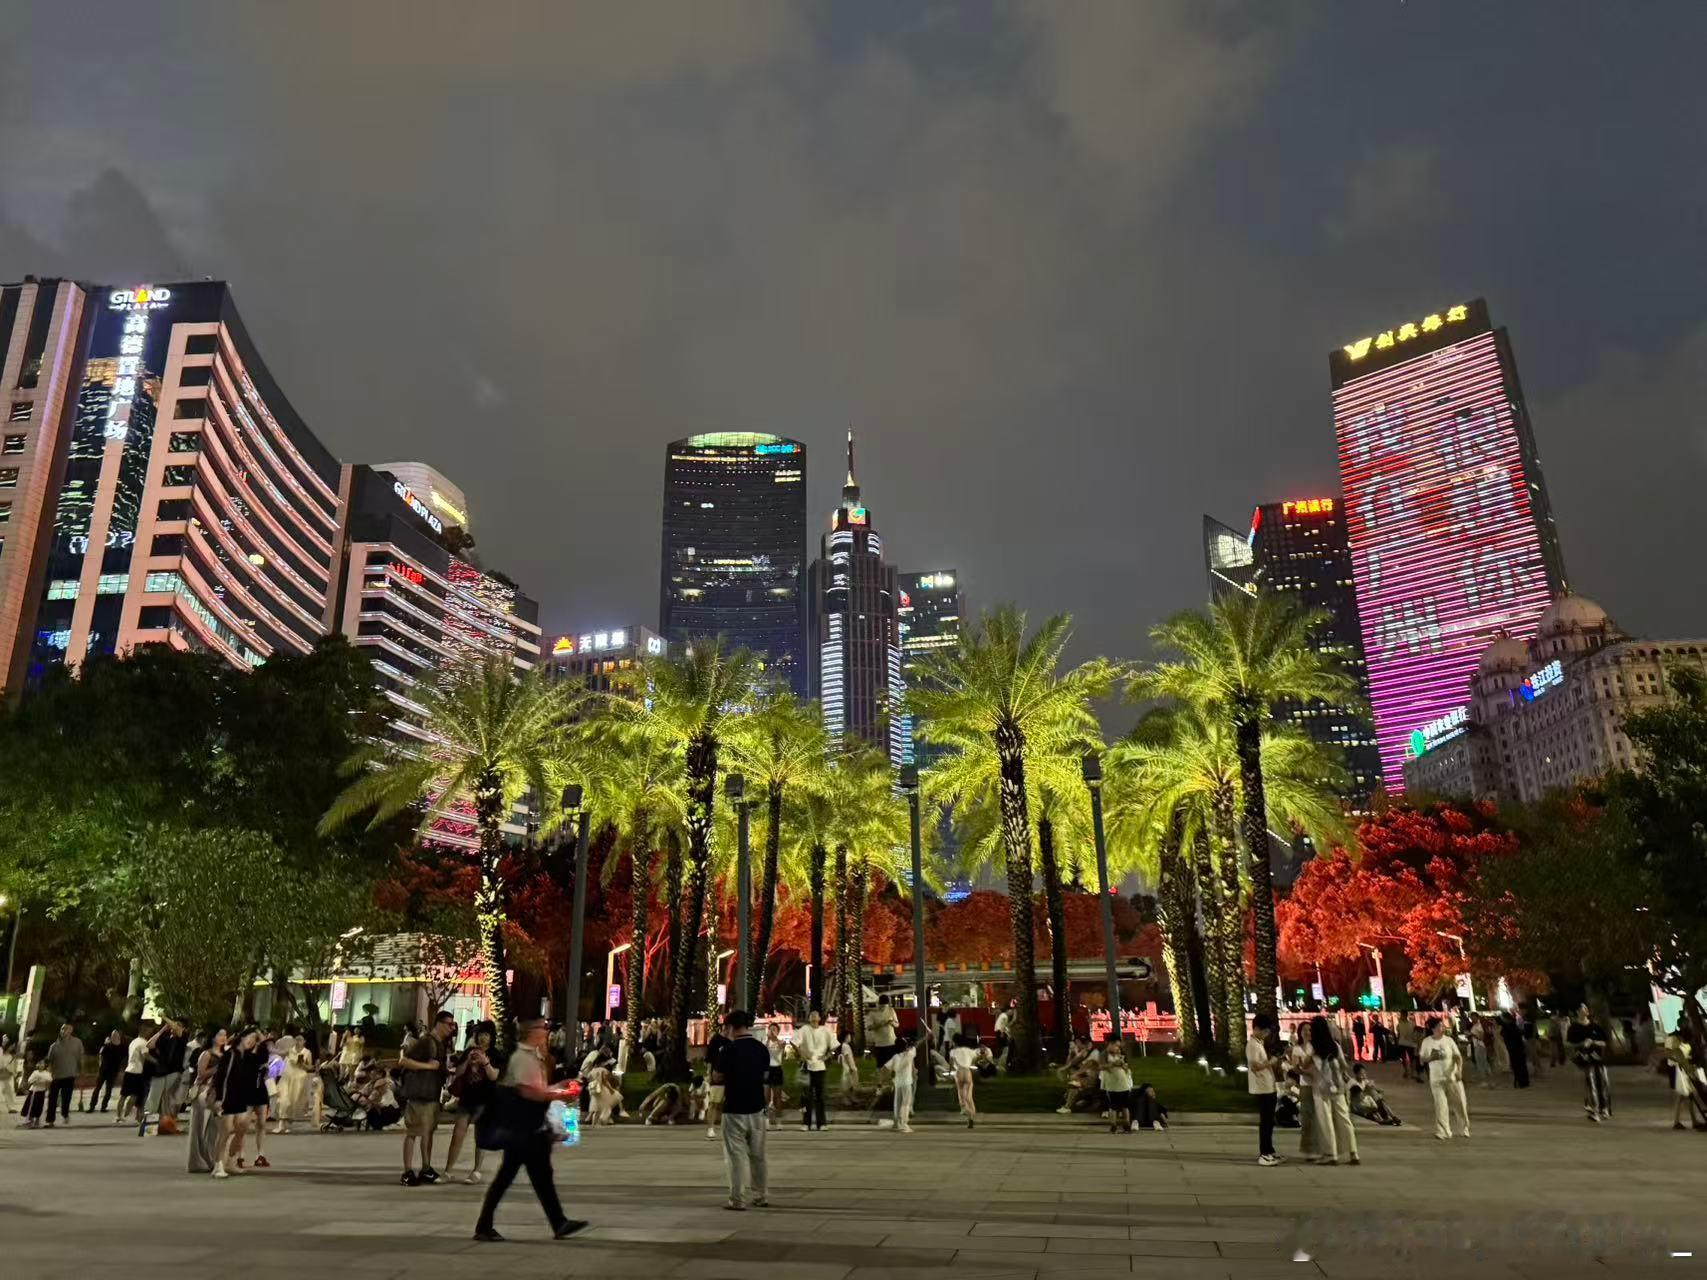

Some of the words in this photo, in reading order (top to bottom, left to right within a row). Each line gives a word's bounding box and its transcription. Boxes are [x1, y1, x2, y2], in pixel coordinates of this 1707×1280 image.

[109, 286, 171, 304] GTLAND
[102, 313, 149, 440] 高德置地广场
[1282, 498, 1333, 515] 广州银行
